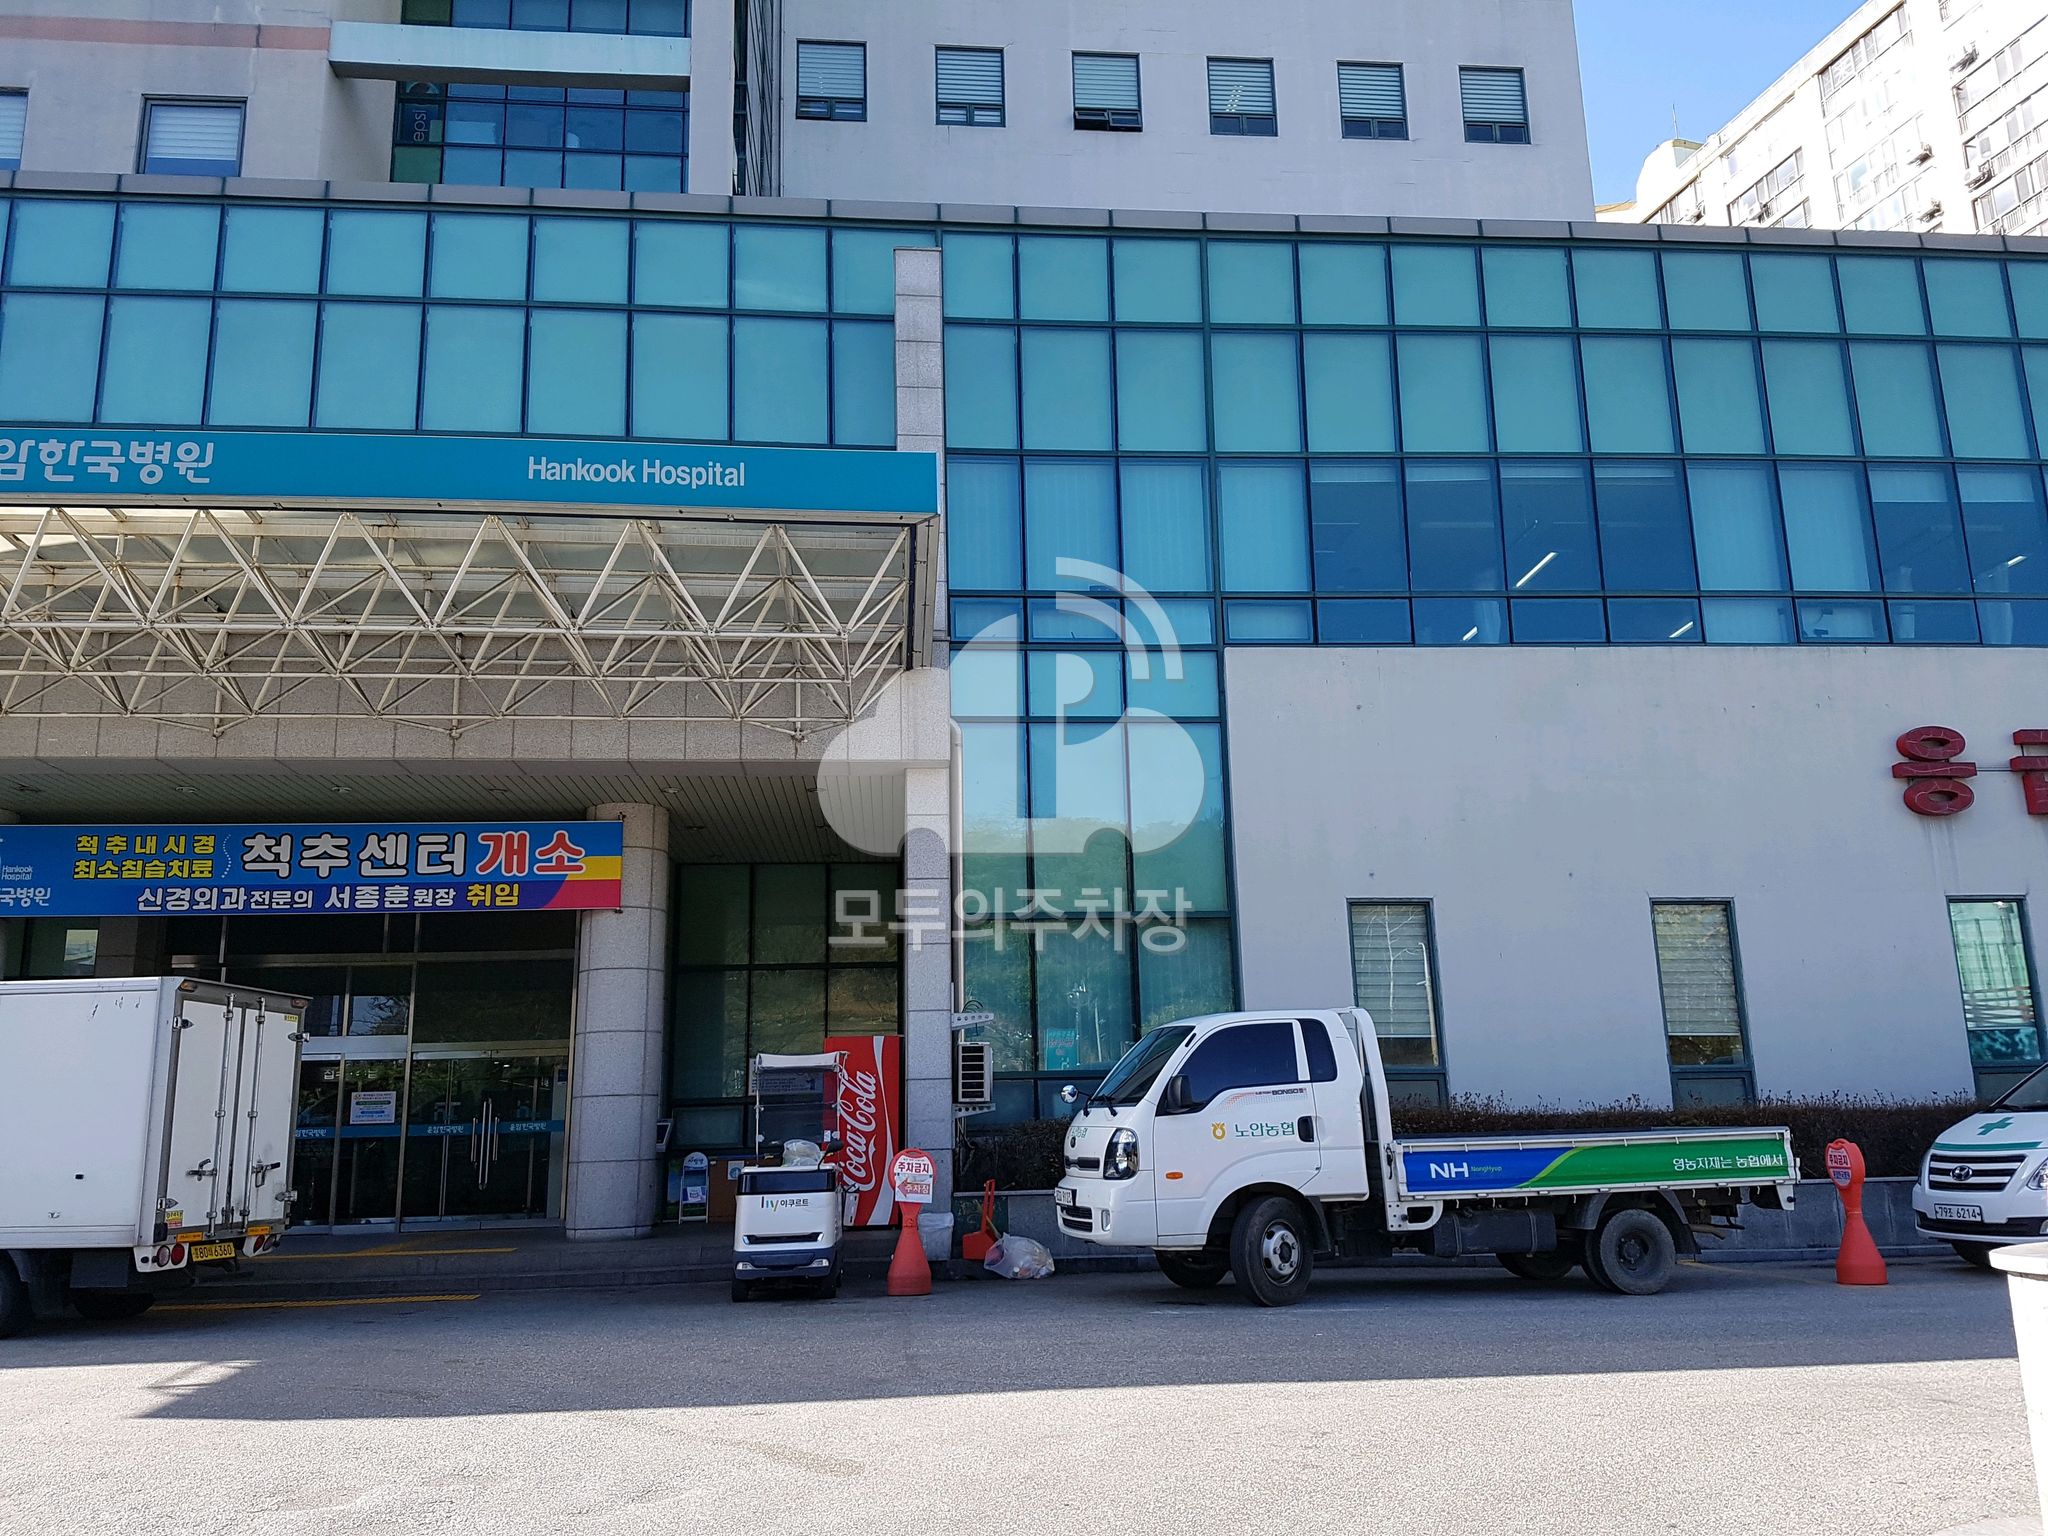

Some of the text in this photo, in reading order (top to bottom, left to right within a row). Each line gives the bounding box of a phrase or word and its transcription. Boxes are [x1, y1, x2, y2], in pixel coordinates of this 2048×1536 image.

[0, 438, 214, 485] 암한국병원
[527, 455, 746, 489] Hankook Hospital
[241, 830, 589, 879] 척추센터 개소
[1, 865, 33, 873] Hankook
[1, 873, 32, 881] Hospital
[466, 883, 520, 907] 취임
[1234, 1121, 1296, 1138] 노안농협
[897, 1161, 930, 1174] 주차금지
[1429, 1162, 1469, 1179] NH
[1672, 1154, 1783, 1171] 영농자재는 농협에서
[1956, 1207, 1977, 1219] 6214
